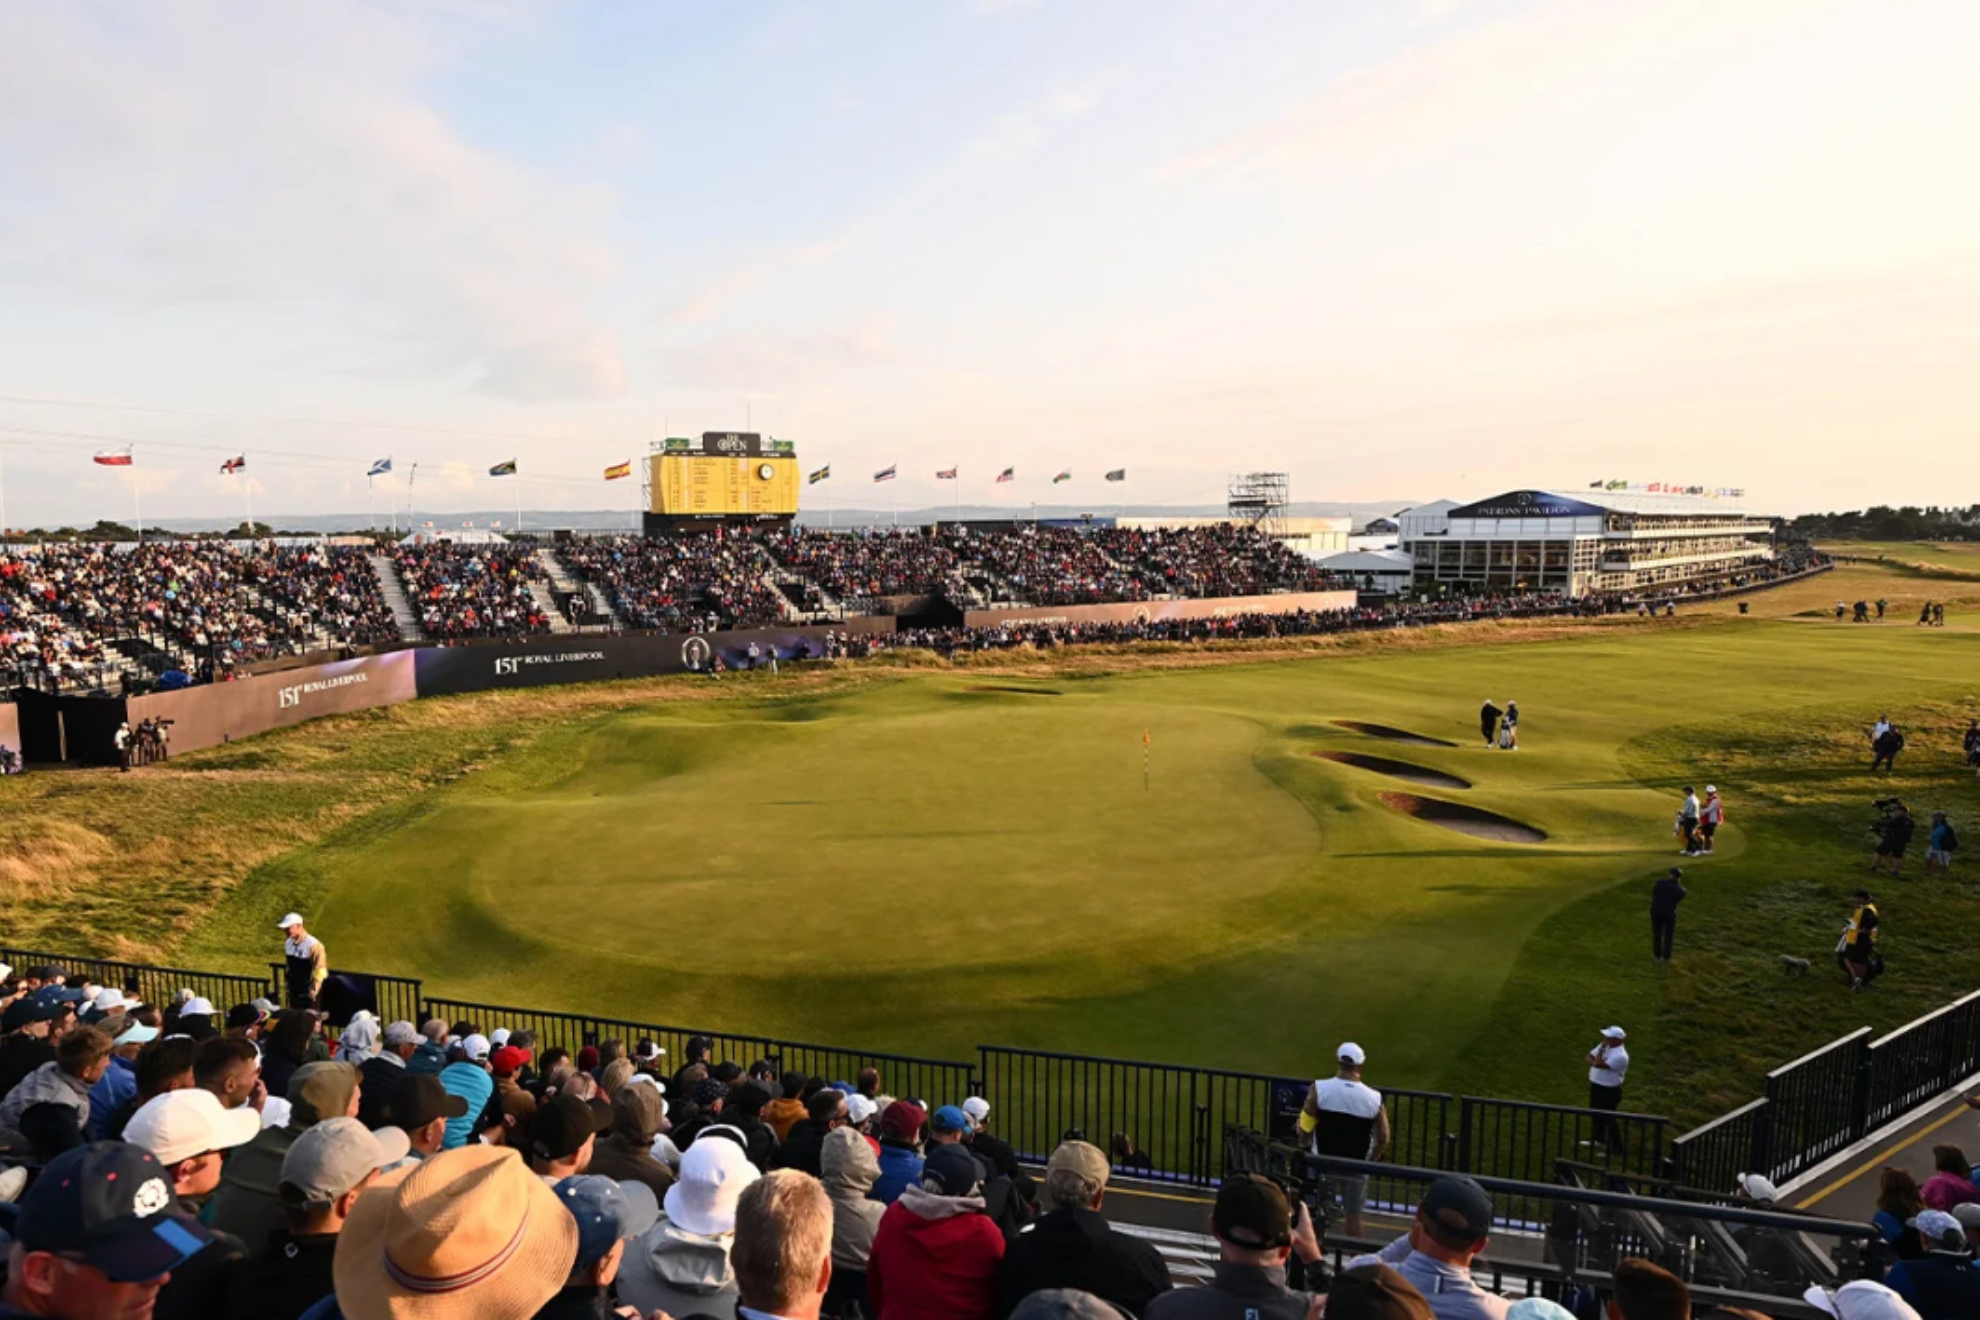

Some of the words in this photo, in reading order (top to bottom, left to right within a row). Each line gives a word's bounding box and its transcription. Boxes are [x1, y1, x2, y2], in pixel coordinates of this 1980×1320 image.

[717, 439, 748, 451] OPEN
[524, 653, 554, 664] ROYAL
[555, 650, 605, 662] LIVERPOOL
[304, 680, 328, 694] ROYAL
[328, 672, 368, 688] LIVERPOOL
